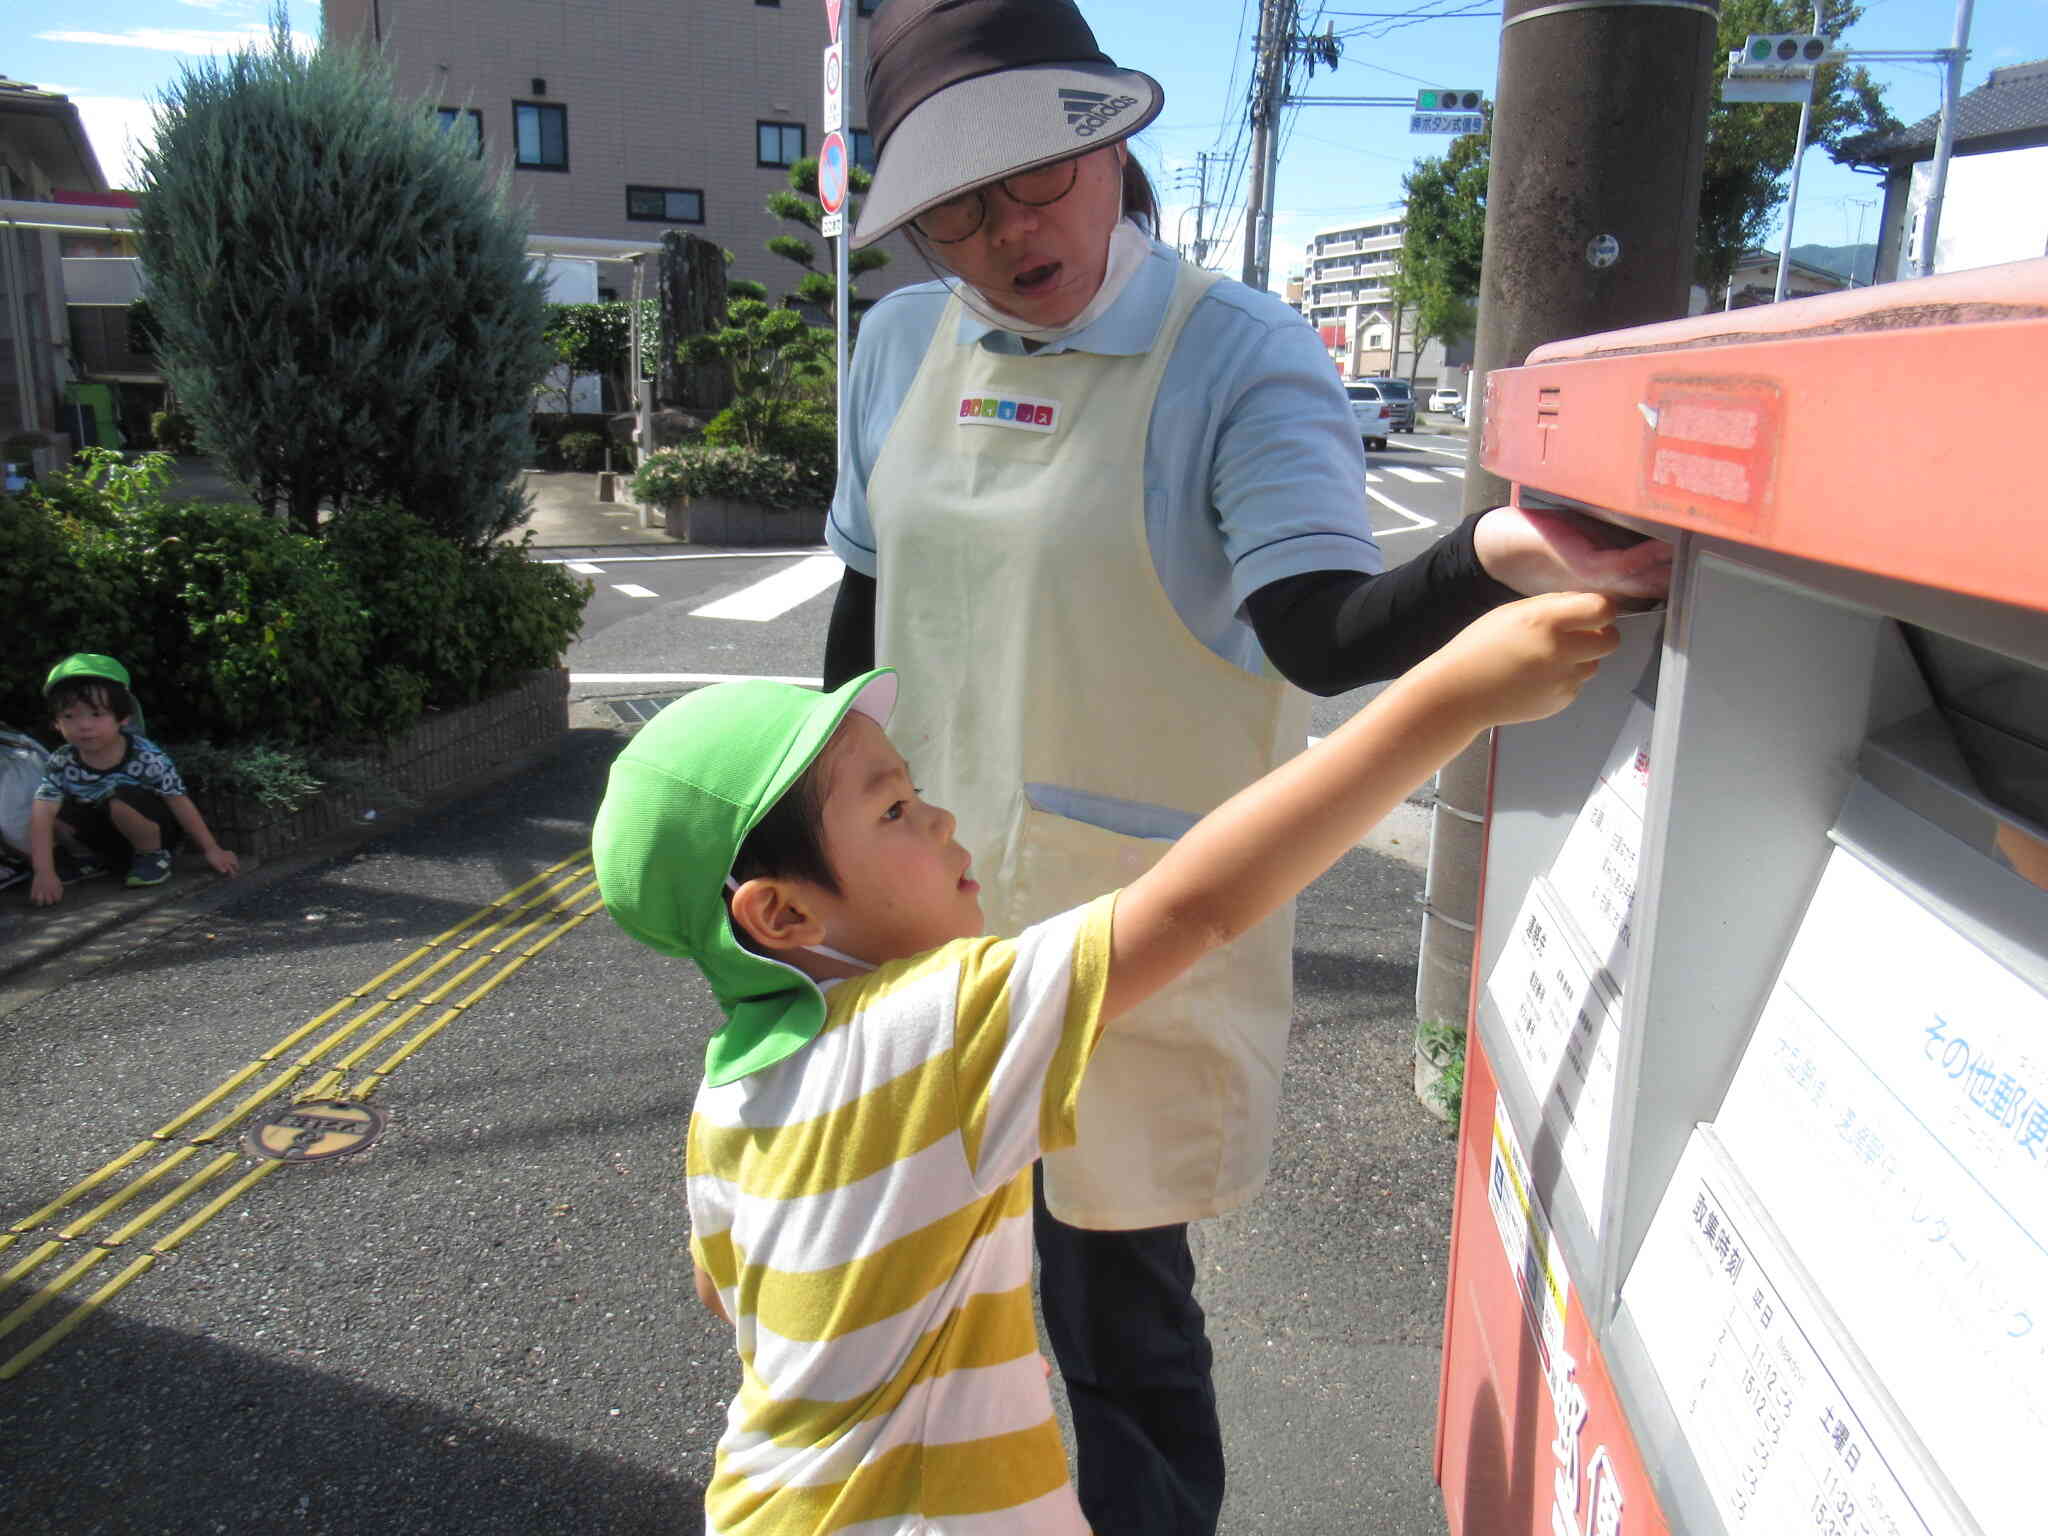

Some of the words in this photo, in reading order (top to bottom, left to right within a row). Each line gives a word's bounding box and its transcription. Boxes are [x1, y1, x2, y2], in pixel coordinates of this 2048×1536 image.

[1075, 95, 1138, 136] adidas
[1692, 1191, 1745, 1286] 取集時刻
[1752, 1287, 1774, 1329] 平日
[1819, 1405, 1861, 1473] 土曜日
